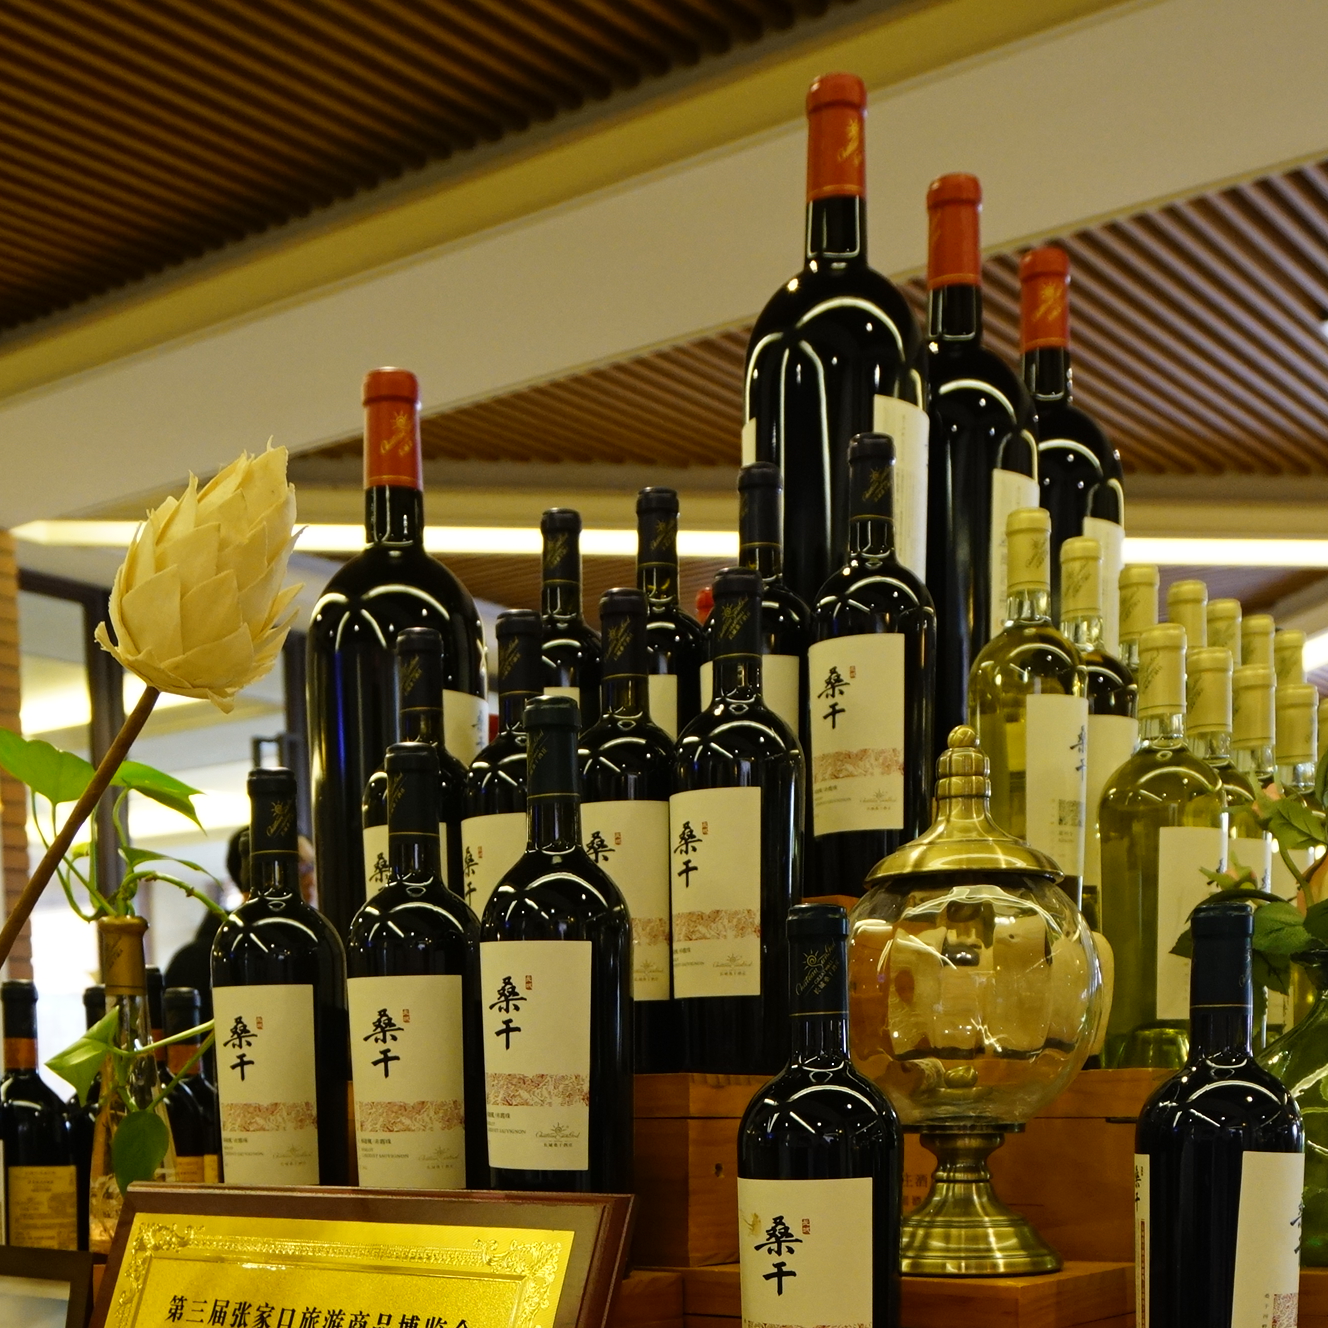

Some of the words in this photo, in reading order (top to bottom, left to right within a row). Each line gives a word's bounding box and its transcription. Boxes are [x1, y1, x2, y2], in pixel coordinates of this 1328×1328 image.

[817, 666, 850, 729] 桑干
[673, 820, 702, 888] 桑干
[363, 1009, 404, 1078] 桑干
[489, 976, 527, 1050] 桑干
[223, 1016, 257, 1081] 桑干
[754, 1215, 803, 1296] 桑干
